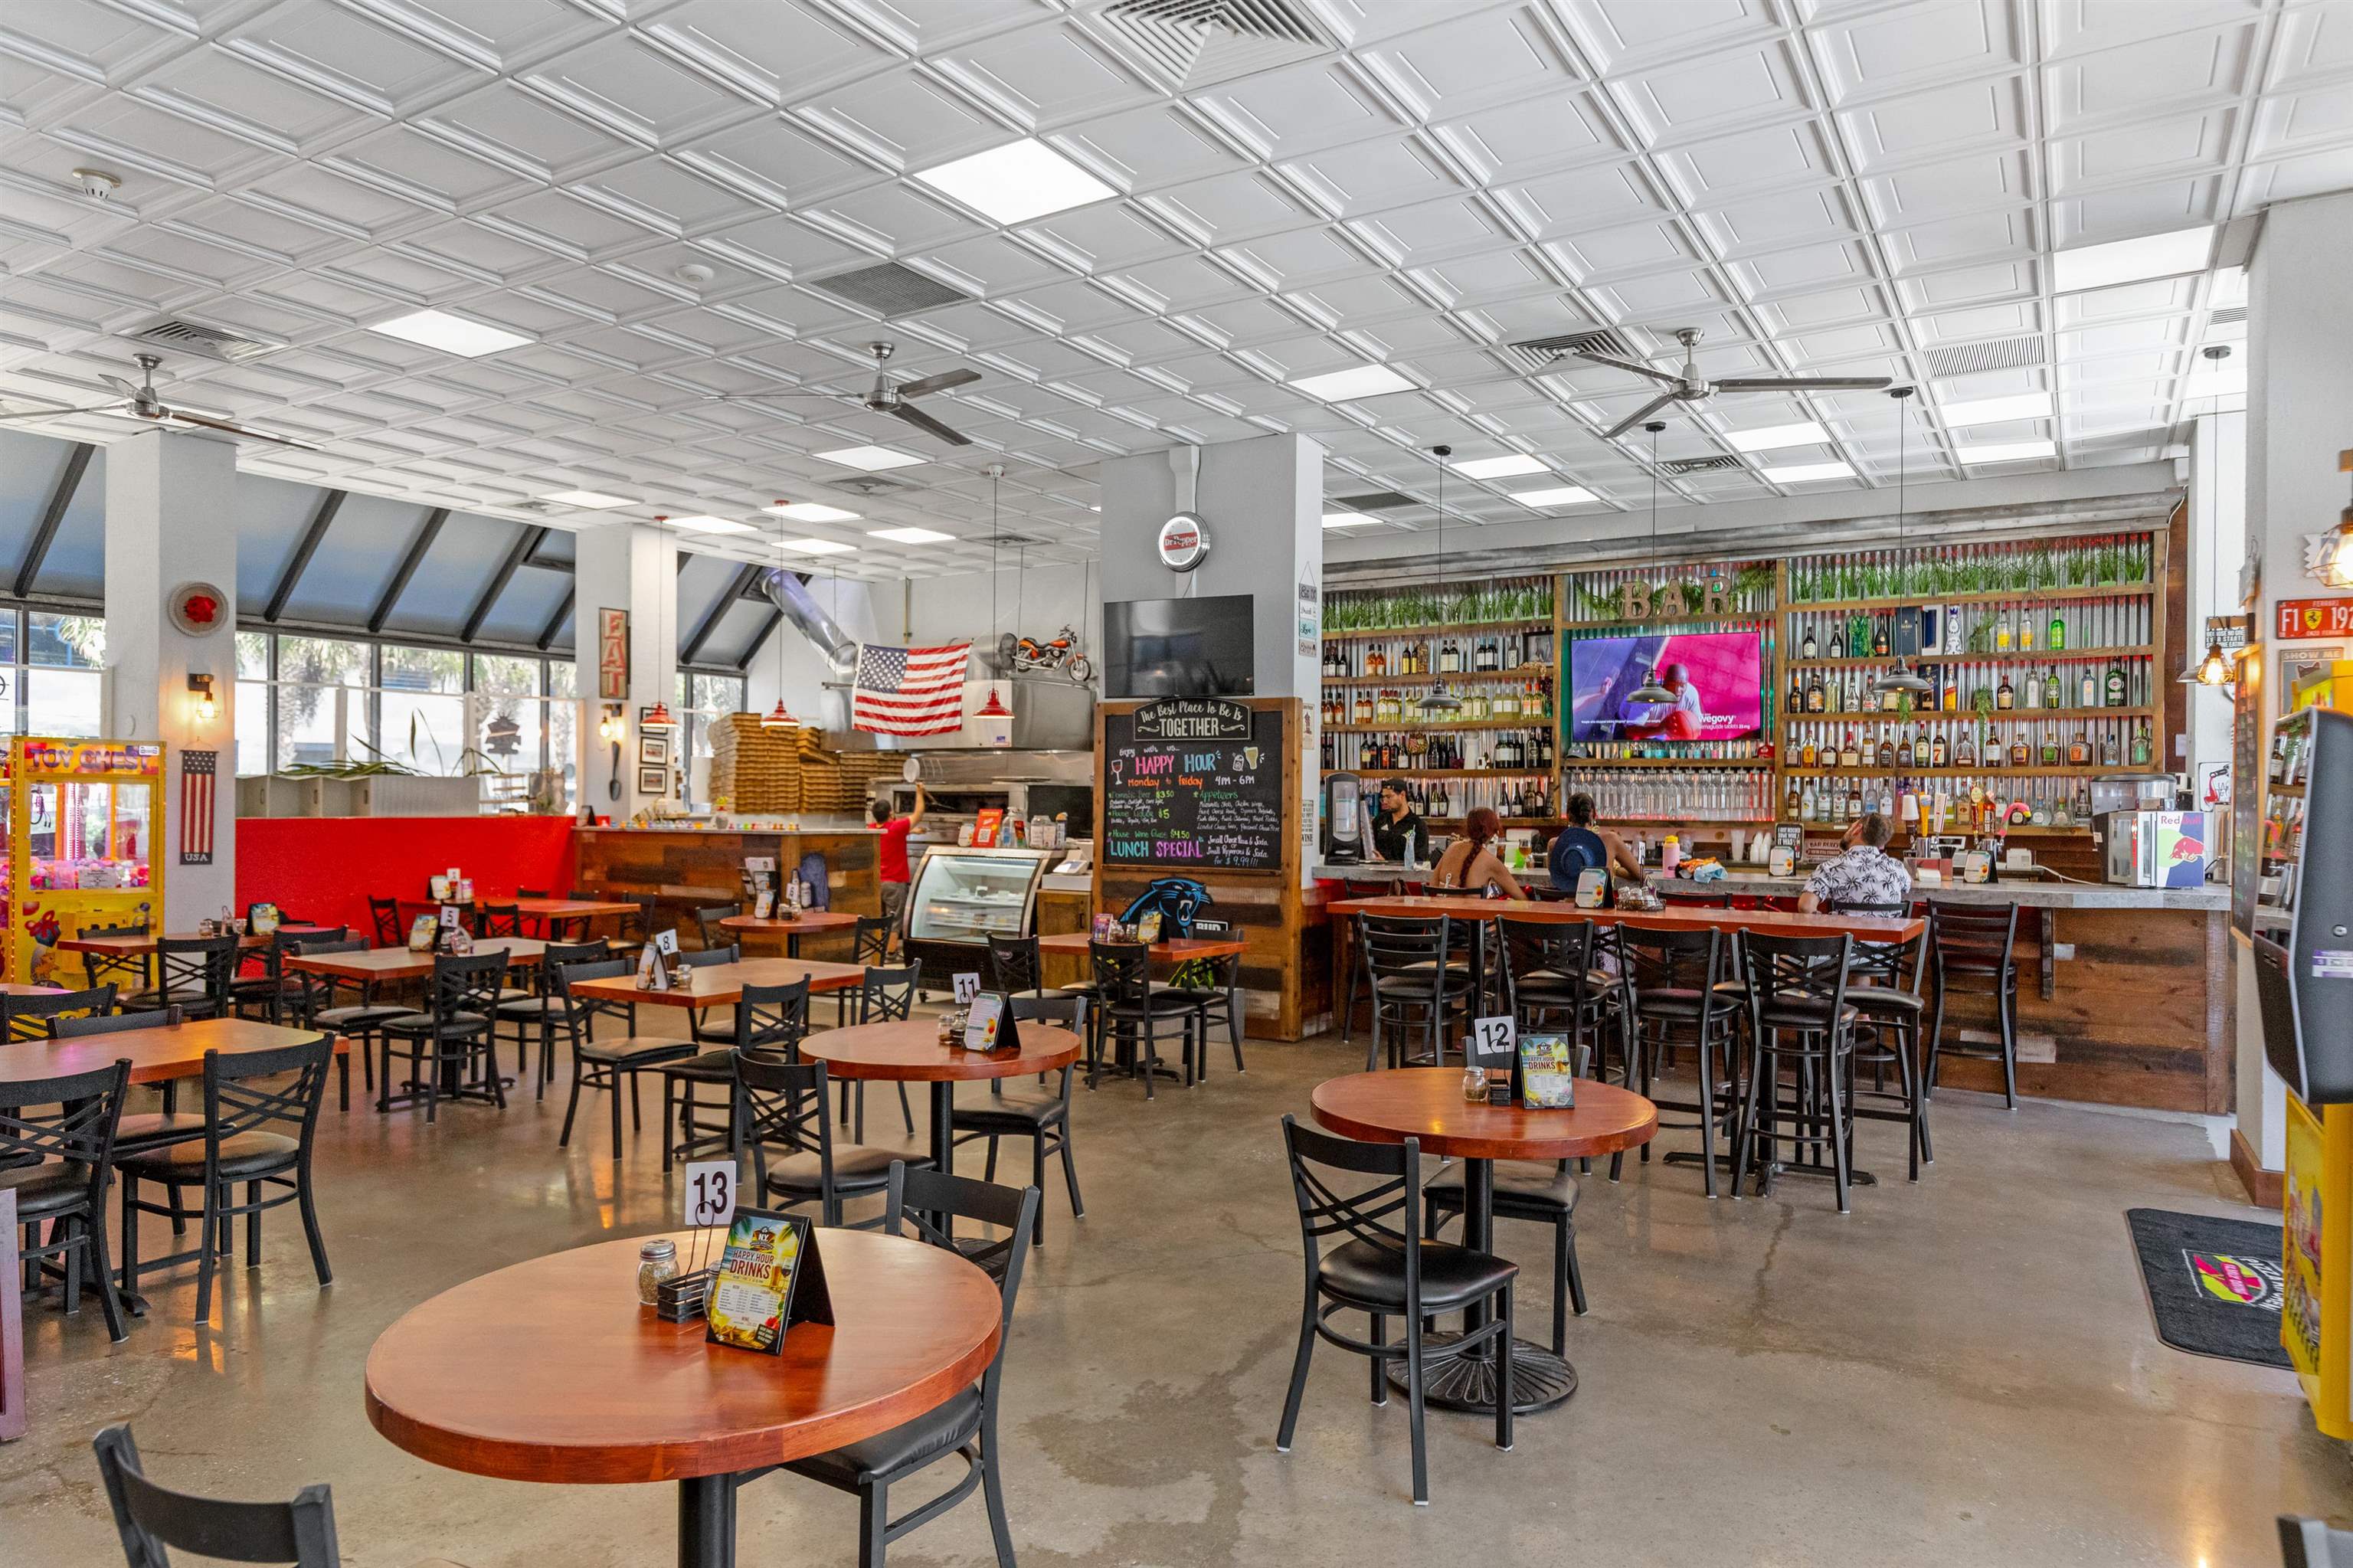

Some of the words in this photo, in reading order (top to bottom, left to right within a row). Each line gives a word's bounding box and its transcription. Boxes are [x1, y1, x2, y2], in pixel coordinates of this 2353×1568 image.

[1165, 538, 1173, 546] Dr
[1173, 535, 1198, 547] Pepper
[1622, 576, 1736, 620] BAR
[2282, 608, 2299, 631] F1
[601, 611, 627, 697] EAT
[2284, 651, 2320, 660] SHOW
[2322, 650, 2342, 659] ME
[1140, 710, 1156, 723] The
[1157, 702, 1178, 718] Best
[1178, 700, 1205, 714] Place
[1206, 700, 1217, 714] To
[1219, 702, 1232, 718] Be
[1233, 706, 1243, 722] Is
[1158, 717, 1219, 737] TOGETHER
[30, 748, 74, 768] TOY
[79, 749, 152, 771] CHEST
[1119, 748, 1135, 758] Enjoy
[1933, 748, 1942, 761] 7
[1135, 755, 1175, 775] HAPPY
[1184, 753, 1216, 773] HOUR
[1127, 775, 1160, 791] Monday
[1178, 774, 1203, 791] Friday
[1215, 775, 1231, 786] 4PM
[1239, 774, 1255, 785] 6PM
[1158, 809, 1170, 819] $5
[2161, 814, 2181, 824] Red
[184, 852, 208, 863] USA
[1110, 840, 1149, 857] LUNCH
[1157, 840, 1203, 858] SPECIAL
[663, 935, 670, 951] 8
[959, 978, 976, 998] 11
[1481, 1023, 1510, 1048] 12
[1528, 1061, 1556, 1070] DRINKS
[693, 1170, 728, 1215] 13
[733, 1249, 755, 1262] HAPPY
[755, 1253, 774, 1264] HOUR
[729, 1259, 771, 1279] DRINKS
